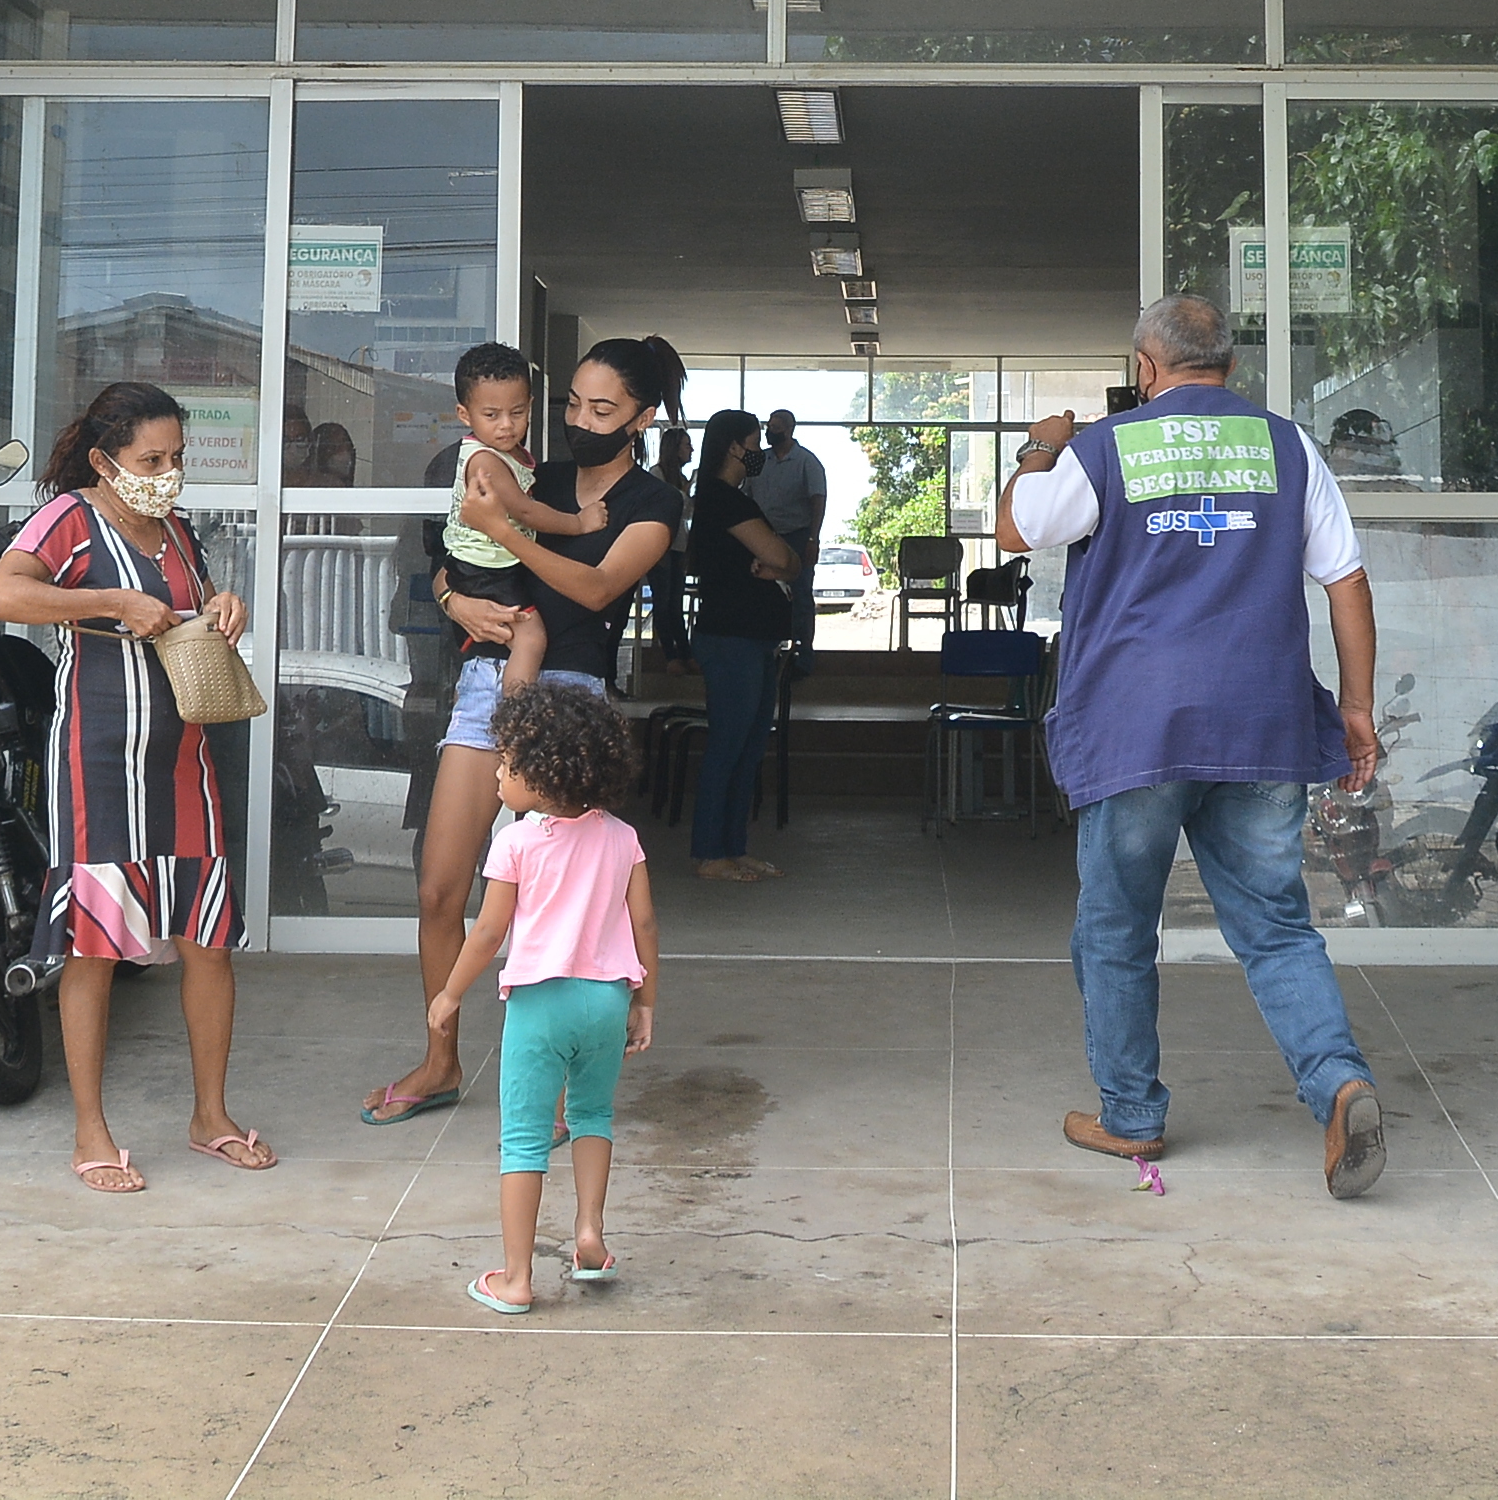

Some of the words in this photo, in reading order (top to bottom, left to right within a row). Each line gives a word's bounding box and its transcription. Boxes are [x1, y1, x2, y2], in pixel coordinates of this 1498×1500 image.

[289, 248, 374, 265] EGURANÇA
[1246, 250, 1343, 266] SERANÇA
[297, 269, 353, 279] OBRIGATÓRIO
[1245, 273, 1263, 281] USO
[1289, 272, 1323, 281] ATÓRIO
[190, 409, 231, 420] TRADA
[1159, 421, 1221, 443] PSF
[198, 437, 237, 448] VERDE
[191, 458, 198, 467] E
[200, 458, 248, 469] ASSPOM
[1124, 447, 1203, 467] VERDES
[1207, 445, 1271, 461] MARES
[1128, 470, 1274, 497] SEGURANÇA
[1149, 512, 1186, 532] SUS
